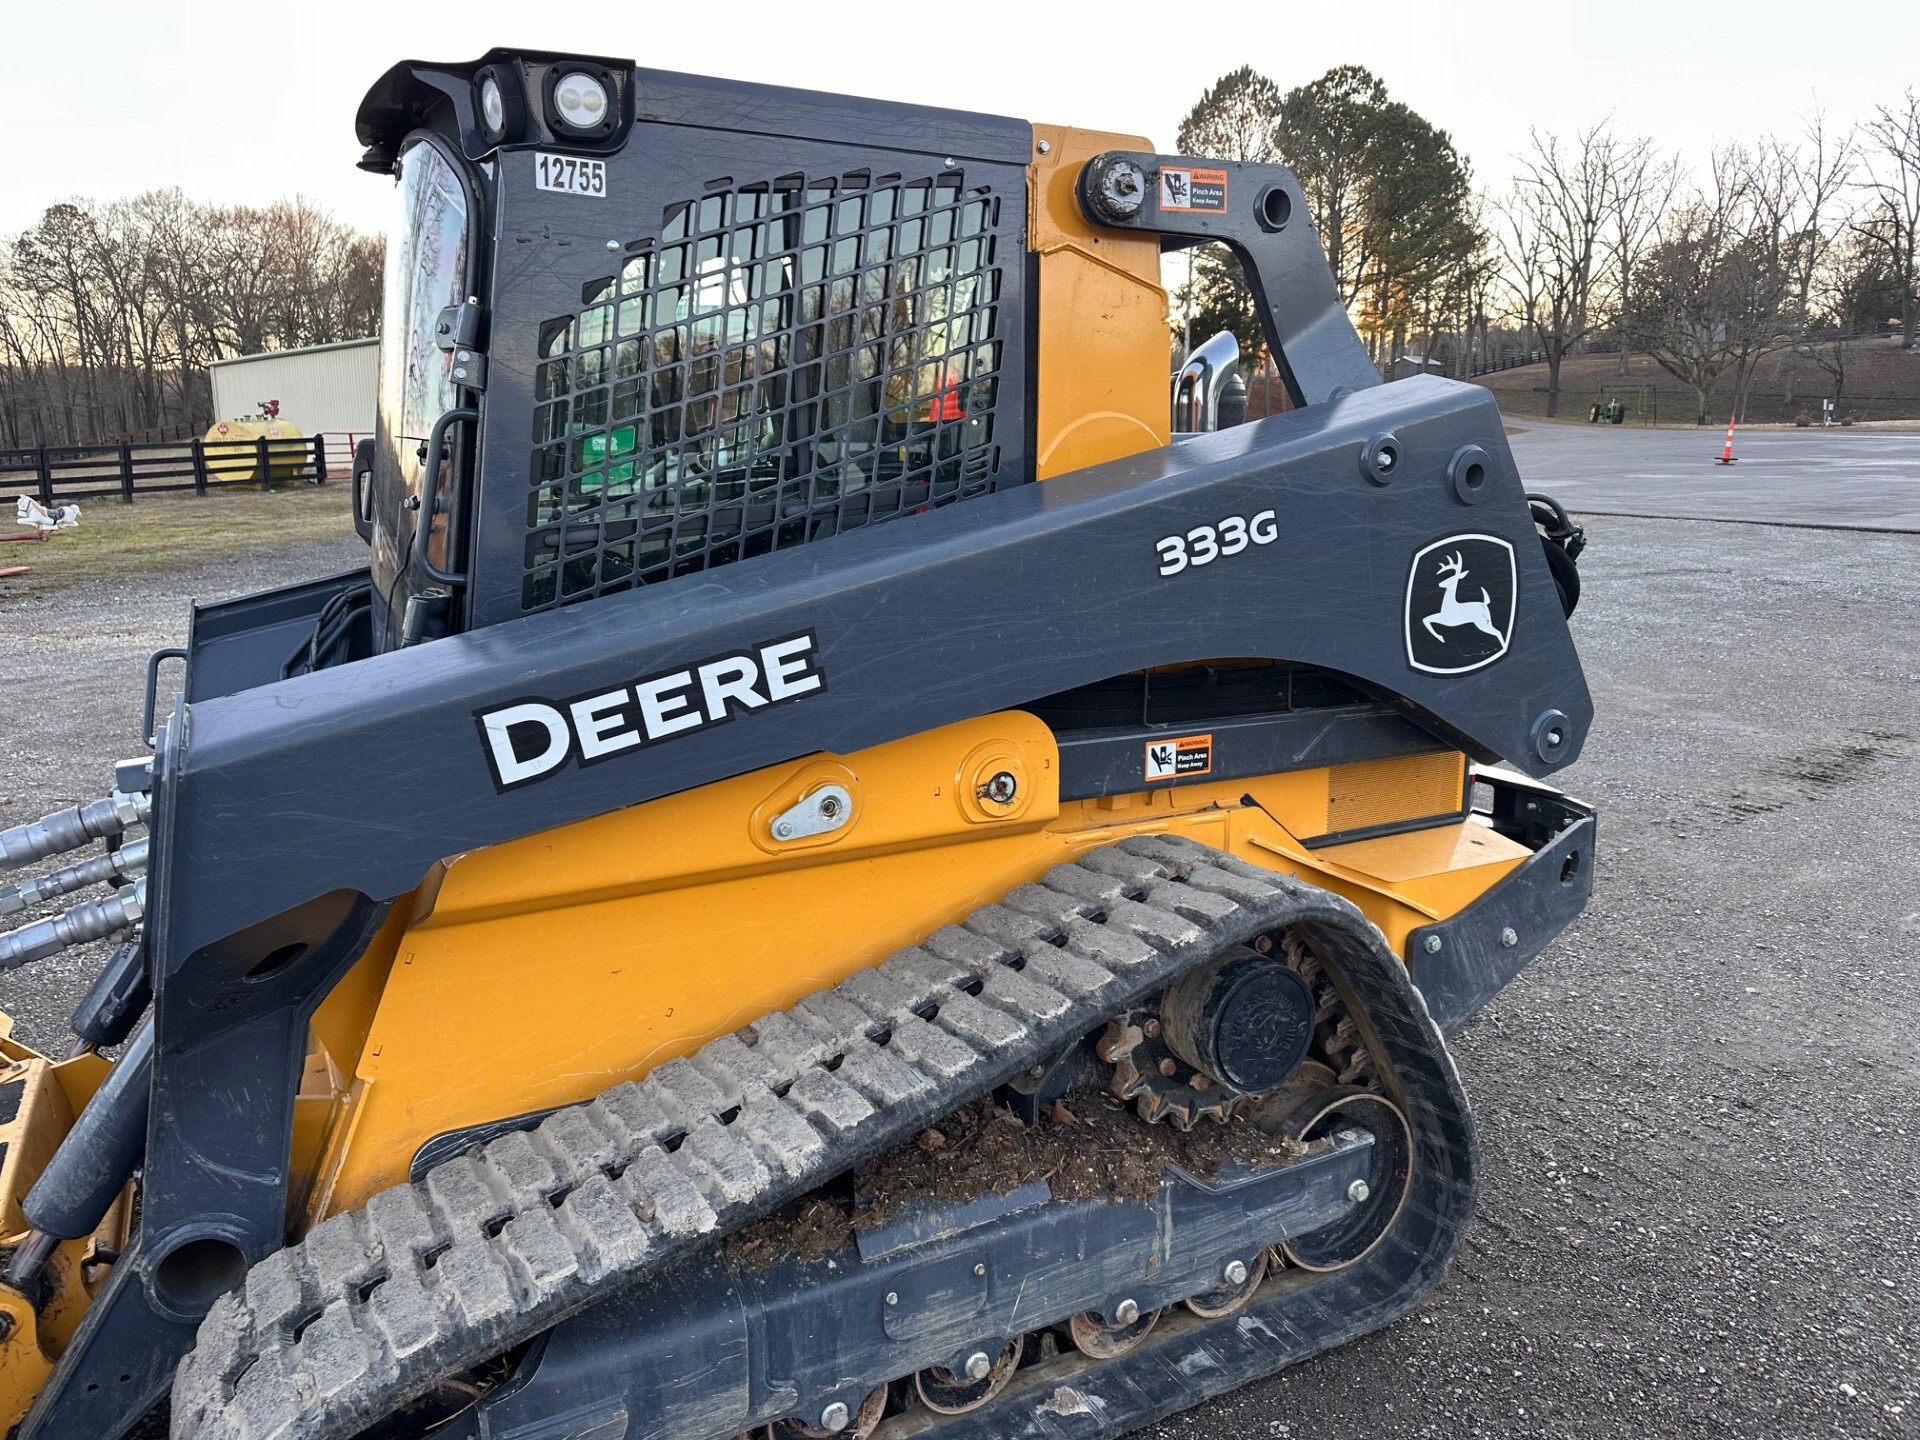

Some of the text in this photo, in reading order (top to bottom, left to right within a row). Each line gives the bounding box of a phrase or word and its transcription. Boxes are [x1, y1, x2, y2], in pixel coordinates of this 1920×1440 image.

[540, 156, 603, 193] 12755
[1199, 173, 1224, 181] WARNING
[1192, 187, 1223, 196] Pinch Area
[1205, 198, 1219, 206] Away
[1156, 509, 1278, 576] 333G
[482, 635, 821, 785] DEERE
[1184, 739, 1208, 747] WARNING
[1194, 752, 1207, 760] Area
